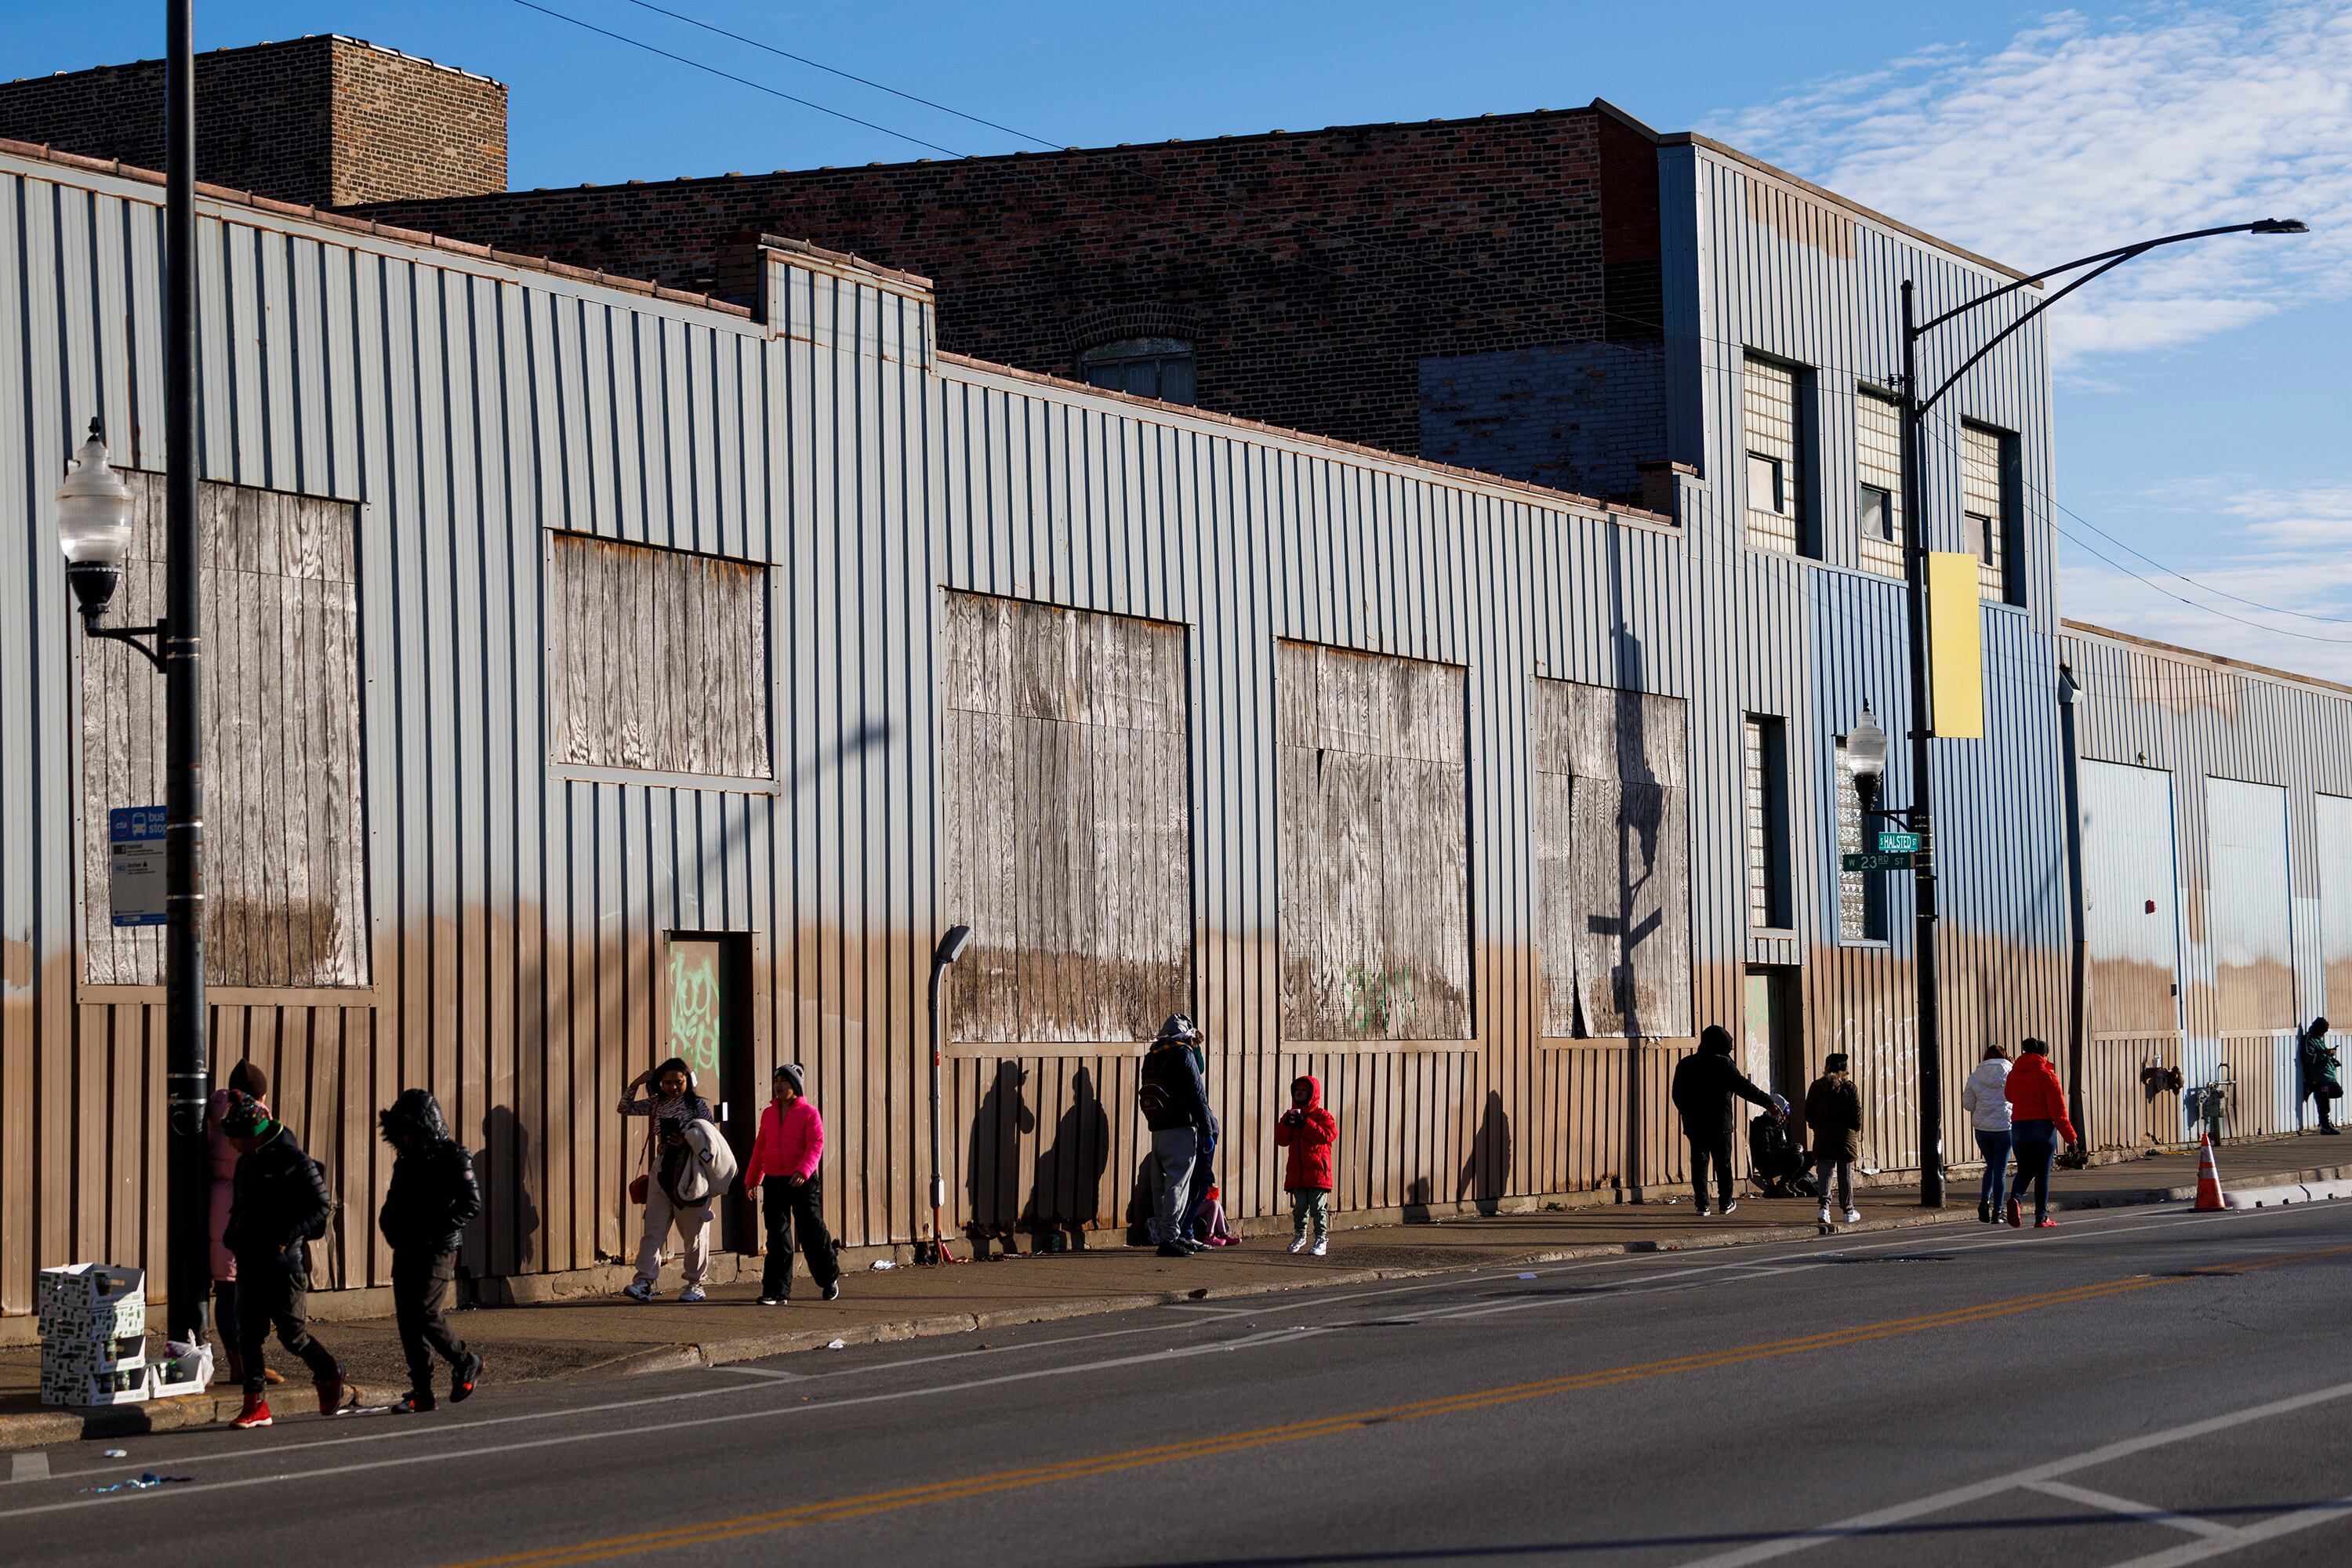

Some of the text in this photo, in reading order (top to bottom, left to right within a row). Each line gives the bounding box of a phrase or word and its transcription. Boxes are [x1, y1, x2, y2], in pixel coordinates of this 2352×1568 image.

[148, 811, 165, 822] bus
[1884, 835, 1911, 848] HALSTED
[1860, 855, 1889, 869] 23RD
[1894, 857, 1904, 866] ST
